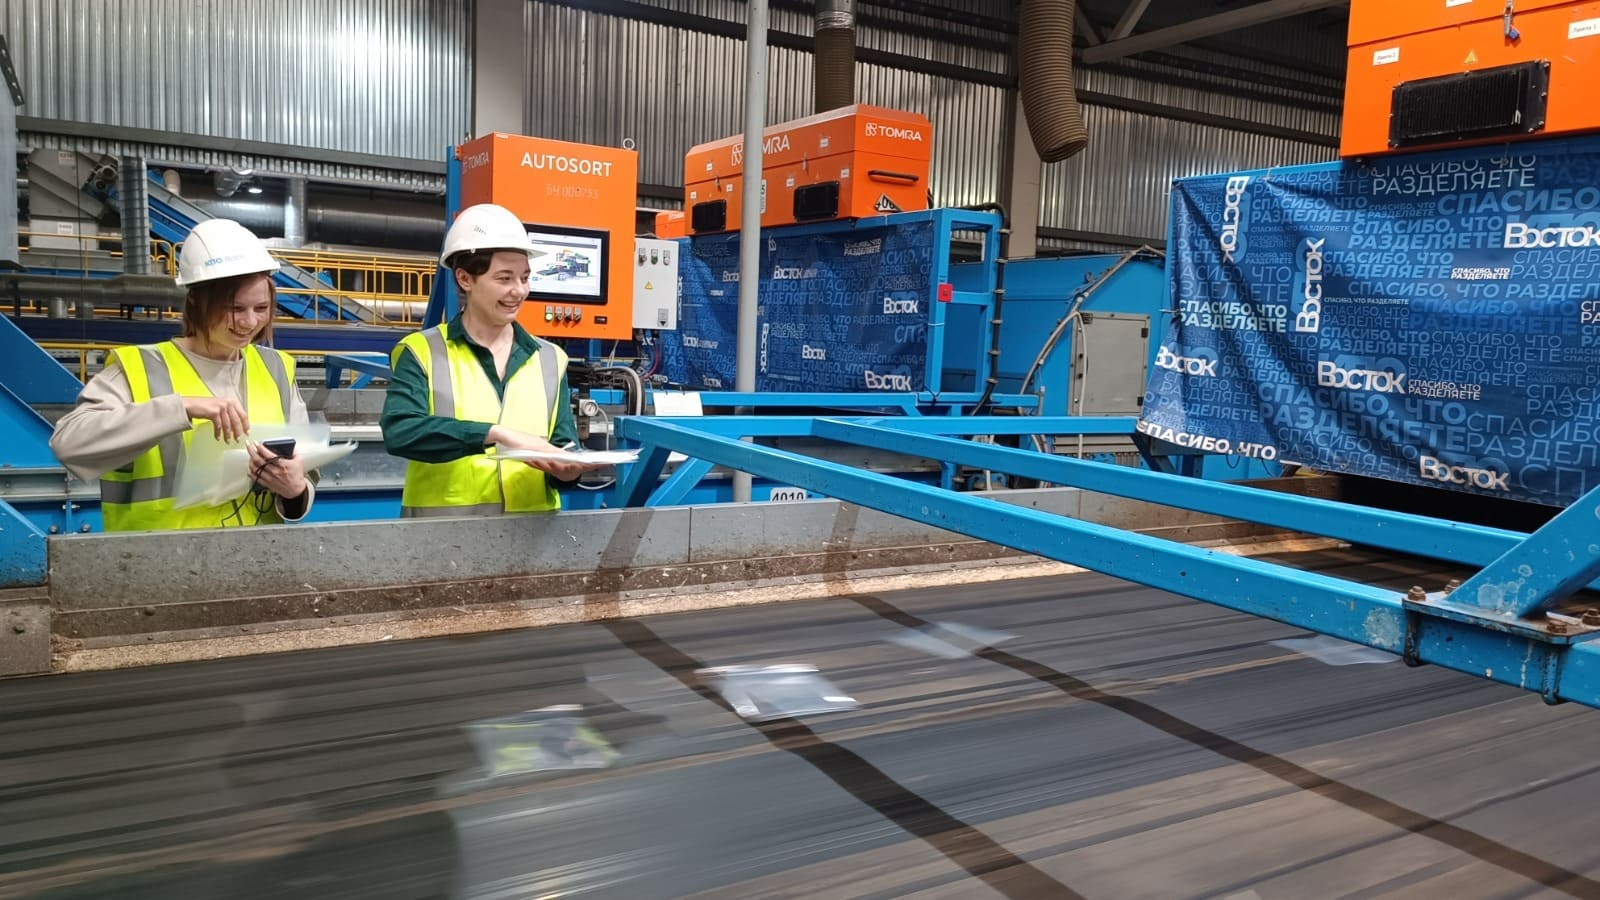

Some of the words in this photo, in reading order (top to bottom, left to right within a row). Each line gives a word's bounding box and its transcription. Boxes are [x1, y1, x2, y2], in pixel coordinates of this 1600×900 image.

[878, 126, 922, 141] TOMRA
[520, 151, 612, 177] AUTOSORT
[1372, 167, 1536, 197] РАЗДЕЛЯЕТЕ
[1252, 197, 1330, 211] СПАСИБО,
[1335, 196, 1368, 209] ЧТО
[1220, 176, 1250, 264] Восток
[1250, 208, 1366, 224] РАЗДЕЛЯЕТЕ
[1351, 218, 1454, 234] СПАСИБО,
[1460, 216, 1503, 231] ЧТО
[1347, 231, 1503, 252] РАЗДЕЛЯЕТЕ
[1323, 251, 1411, 266] СПАСИБО,
[1417, 252, 1454, 265] ЧТО
[774, 265, 803, 280] Восток
[1252, 265, 1293, 283] ЧТО
[1323, 264, 1452, 279] РАЗДЕЛЯЕТЕ
[1296, 238, 1325, 332] Восток
[1348, 281, 1449, 299] СПАСИБО,
[1455, 283, 1500, 298] ЧТО
[883, 297, 919, 314] Восток
[1180, 300, 1254, 318] СПАСИБО,
[1256, 304, 1288, 318] ЧТО
[1410, 299, 1523, 317] СПАСИБО,
[1410, 313, 1578, 335] РАЗДЕЛЯЕТЕ
[1320, 327, 1394, 341] СПАСИБО,
[1398, 330, 1430, 343] ЧТО
[1432, 331, 1520, 347] СПАСИБО,
[1525, 333, 1562, 348] ЧТО
[1320, 338, 1431, 356] РАЗДЕЛЯЕТЕ
[1431, 343, 1561, 362] РАЗДЕЛЯЕТЕ
[1408, 356, 1488, 374] СПАСИБО,
[1493, 361, 1527, 375] ЧТО
[864, 370, 912, 391] Восток
[1317, 361, 1406, 395] Восток
[1408, 367, 1527, 388] РАЗДЕЛЯЕТЕ
[1408, 379, 1456, 391] СПАСИБО,
[1460, 383, 1481, 393] ЧТО
[1408, 386, 1481, 401] РАЗДЕЛЯЕТЕ
[1258, 382, 1395, 418] СПАСИБО,
[1405, 399, 1467, 425] ЧТО
[1259, 402, 1467, 451] РАЗДЕЛЯЕТЕ
[1237, 441, 1277, 461] ЧТО
[1419, 455, 1511, 493] Восток
[772, 491, 804, 502] 4010
